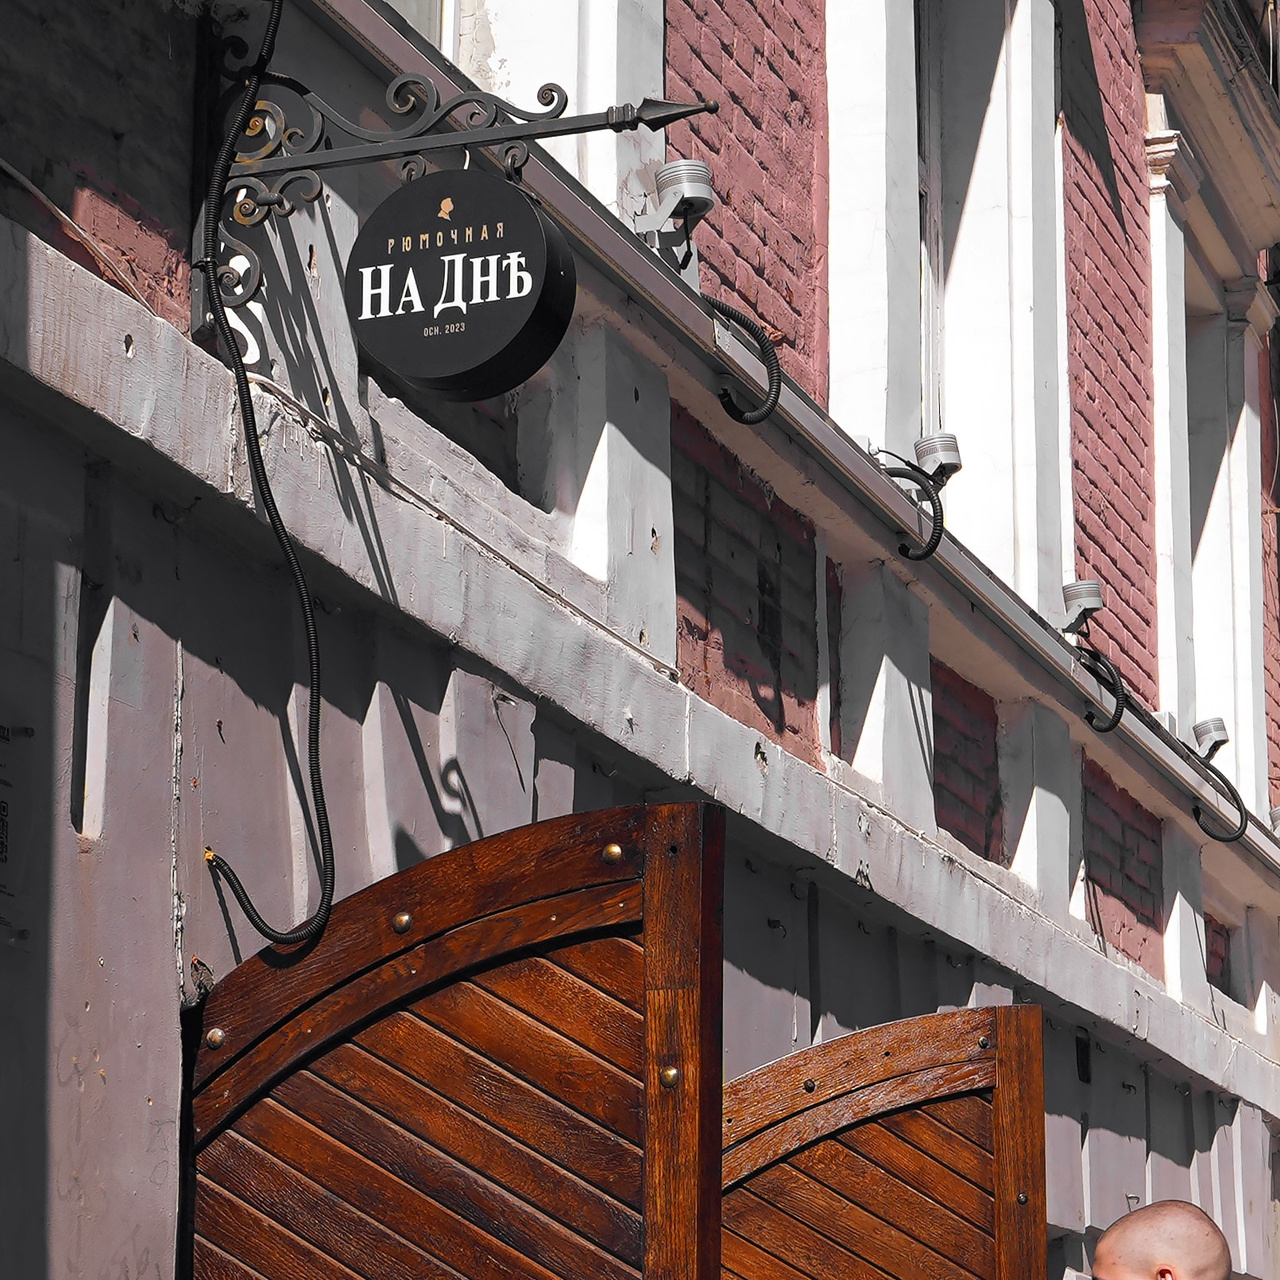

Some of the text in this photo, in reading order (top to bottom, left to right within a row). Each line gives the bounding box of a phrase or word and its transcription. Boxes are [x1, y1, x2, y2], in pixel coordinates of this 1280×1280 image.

[387, 222, 504, 254] РЮМОЧНАЯ
[358, 263, 425, 320] НА
[423, 322, 466, 337] ОСН. 2023
